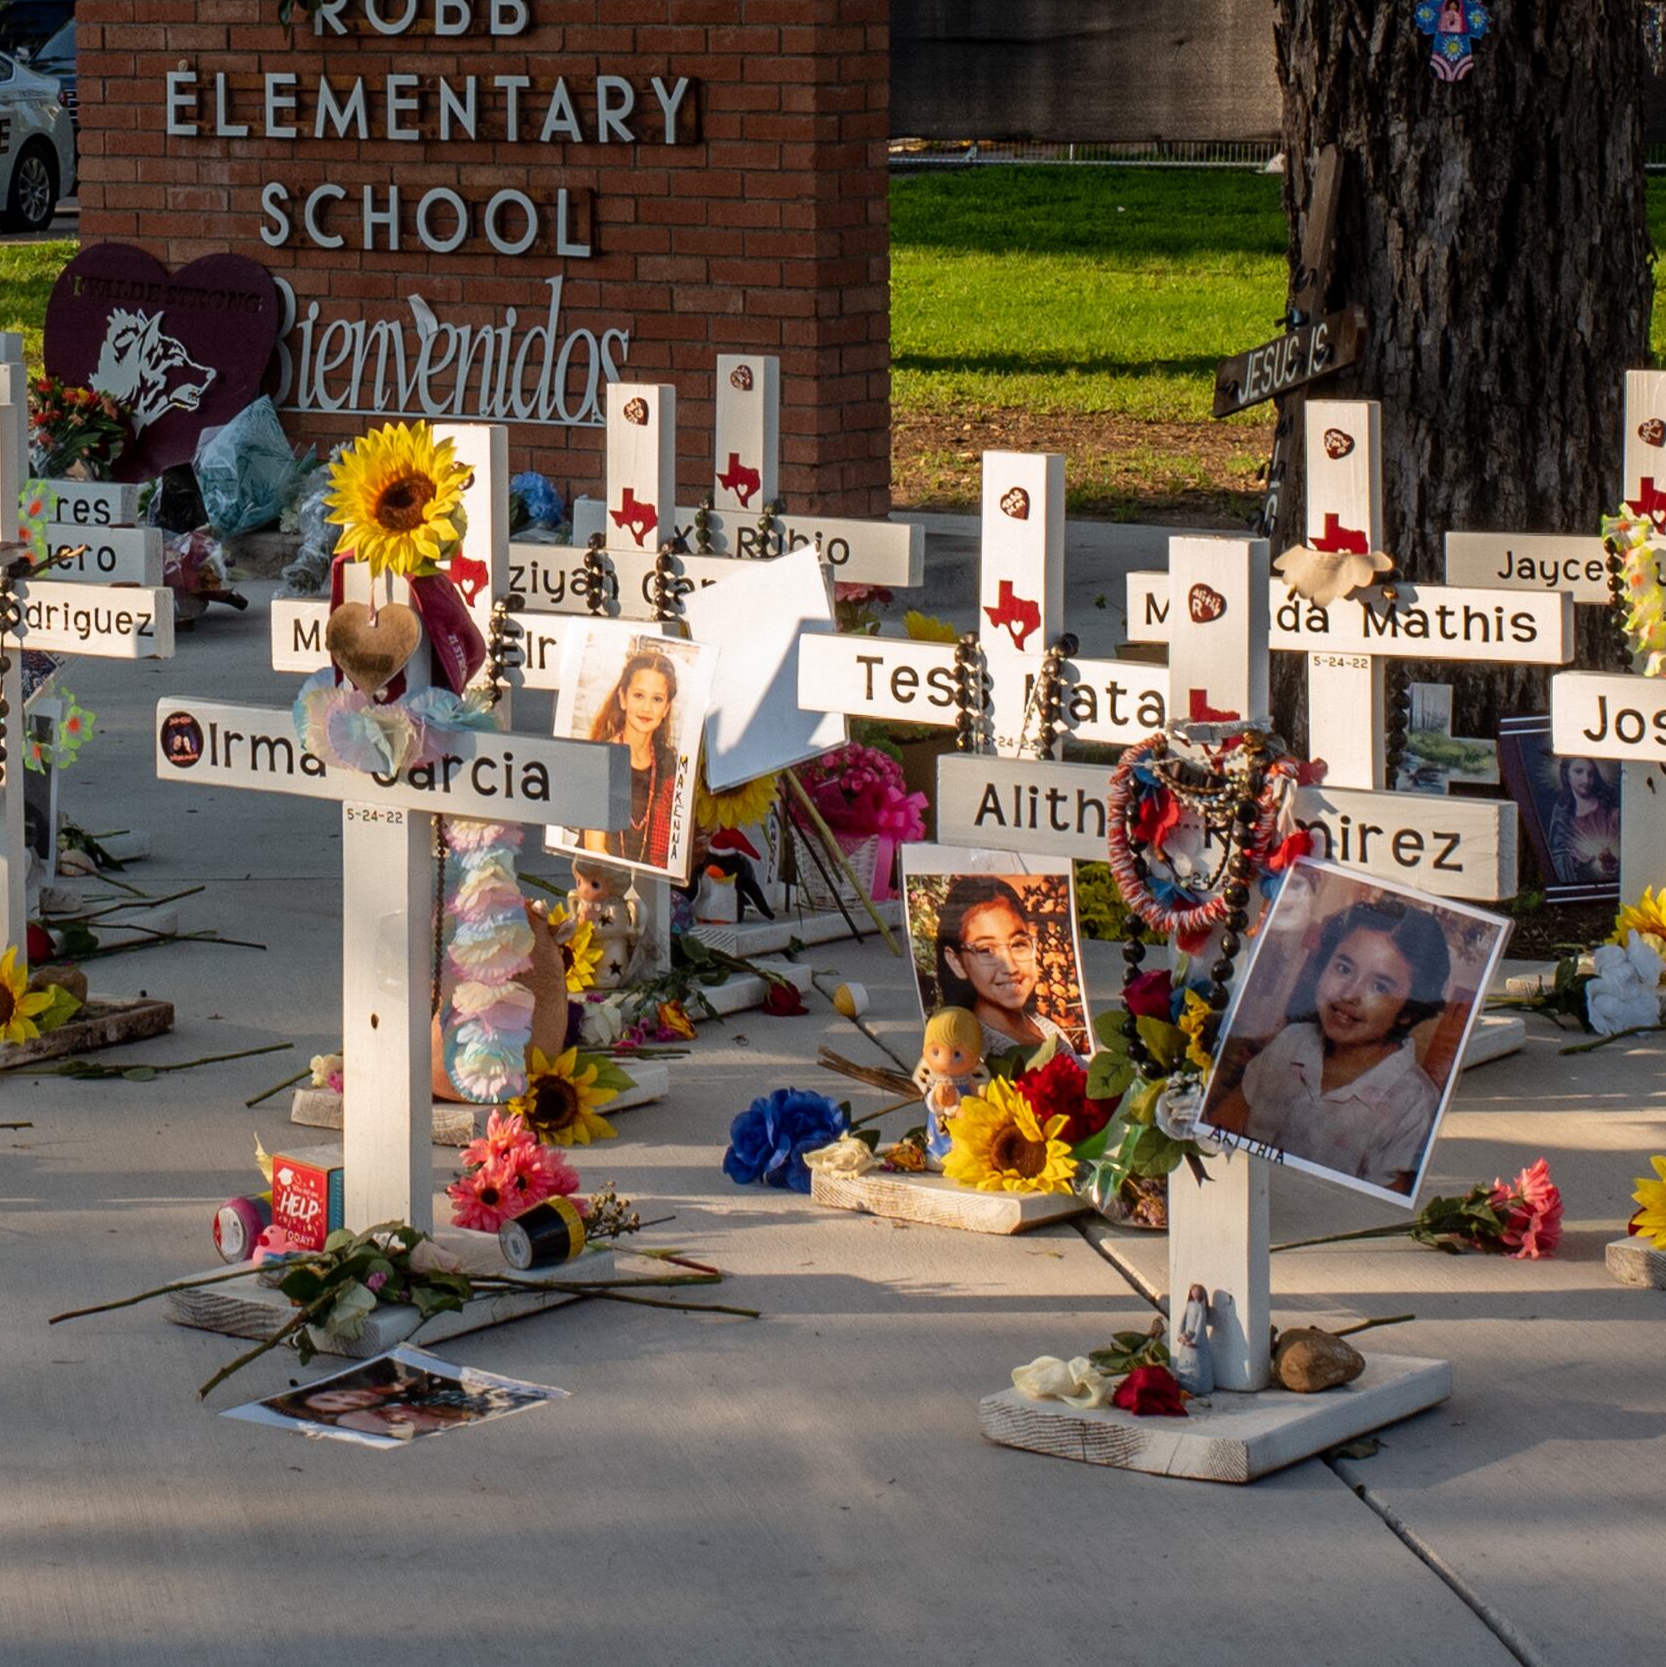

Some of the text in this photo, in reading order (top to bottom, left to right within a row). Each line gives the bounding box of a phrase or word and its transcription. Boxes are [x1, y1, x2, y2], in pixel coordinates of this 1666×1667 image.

[166, 71, 691, 146] ELEMENTARY
[260, 182, 593, 258] SCHOOL
[166, 285, 264, 313] STRONG
[1238, 322, 1329, 405] JESUS IS
[1497, 550, 1604, 588] Jayce
[1362, 601, 1538, 643] Mathis
[856, 655, 990, 709] Tes
[1314, 655, 1369, 669] 5-24-22
[209, 722, 327, 779] Irma
[346, 808, 404, 824] 5-24-22
[669, 754, 689, 861] MAKENNA
[974, 783, 1107, 836] Alith
[279, 1190, 319, 1223] HELP
